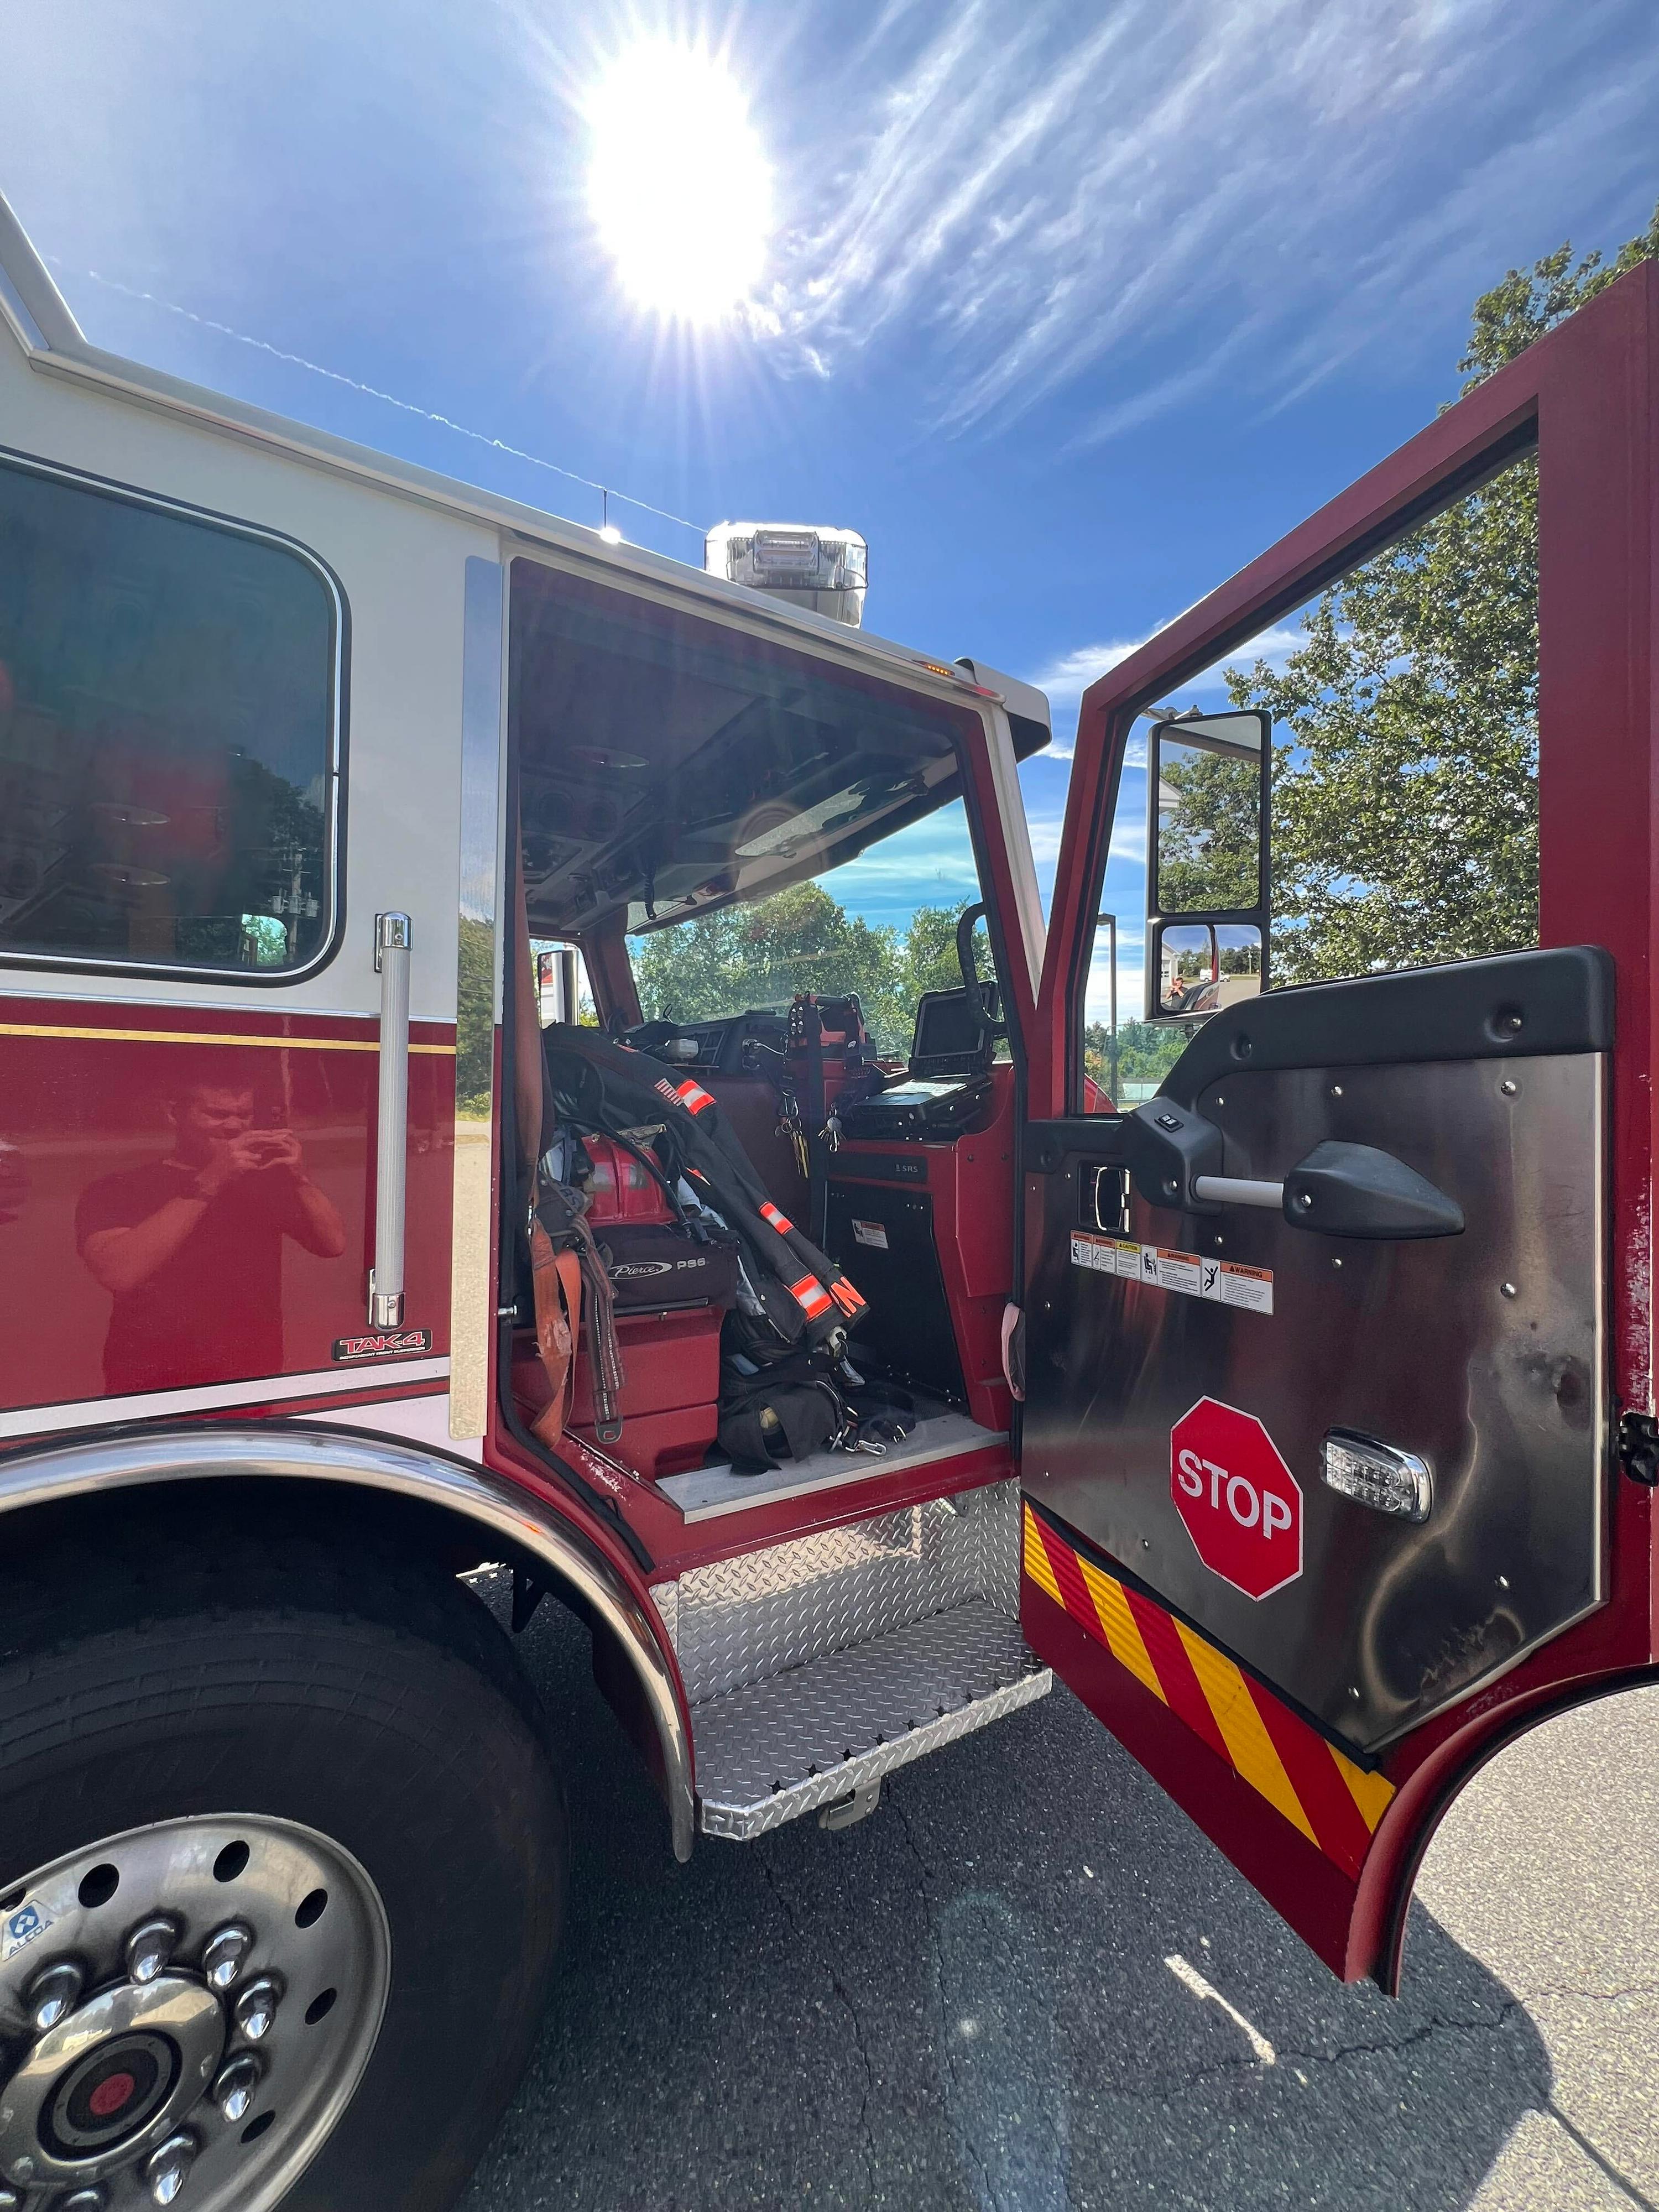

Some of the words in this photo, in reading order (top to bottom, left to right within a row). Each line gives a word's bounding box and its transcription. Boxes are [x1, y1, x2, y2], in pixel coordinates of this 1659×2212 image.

[614, 1265, 655, 1277] Pierce
[1234, 1266, 1263, 1279] WARNING
[340, 1331, 426, 1354] TAK-4
[1178, 1448, 1292, 1540] STOP
